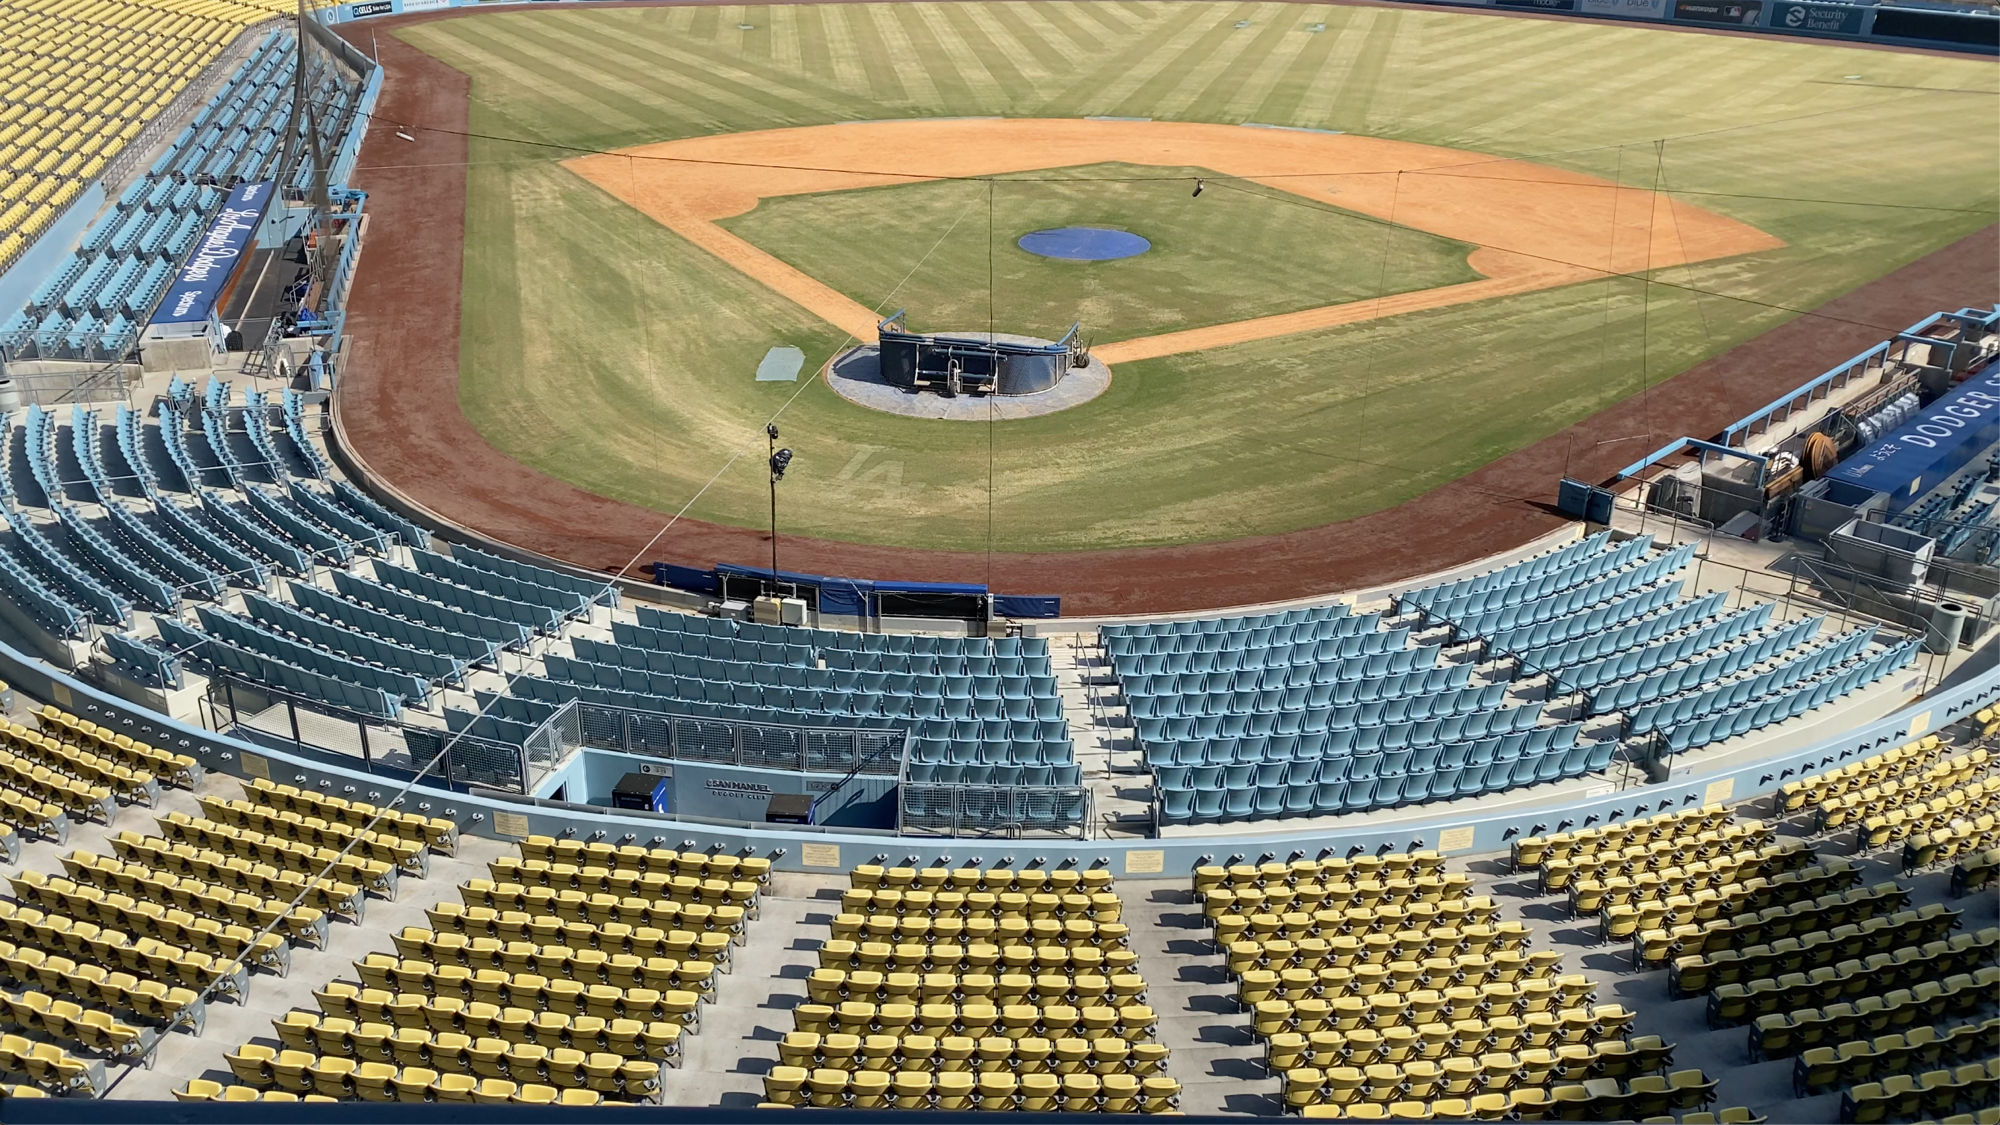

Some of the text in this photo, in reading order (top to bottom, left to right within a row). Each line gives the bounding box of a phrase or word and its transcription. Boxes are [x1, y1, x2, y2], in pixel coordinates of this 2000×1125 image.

[1808, 8, 1848, 23] Security
[1807, 18, 1840, 31] Benefit
[172, 290, 203, 317] Spectrum
[1900, 390, 2000, 448] DODGER
[713, 780, 771, 793] SAN MANUEL
